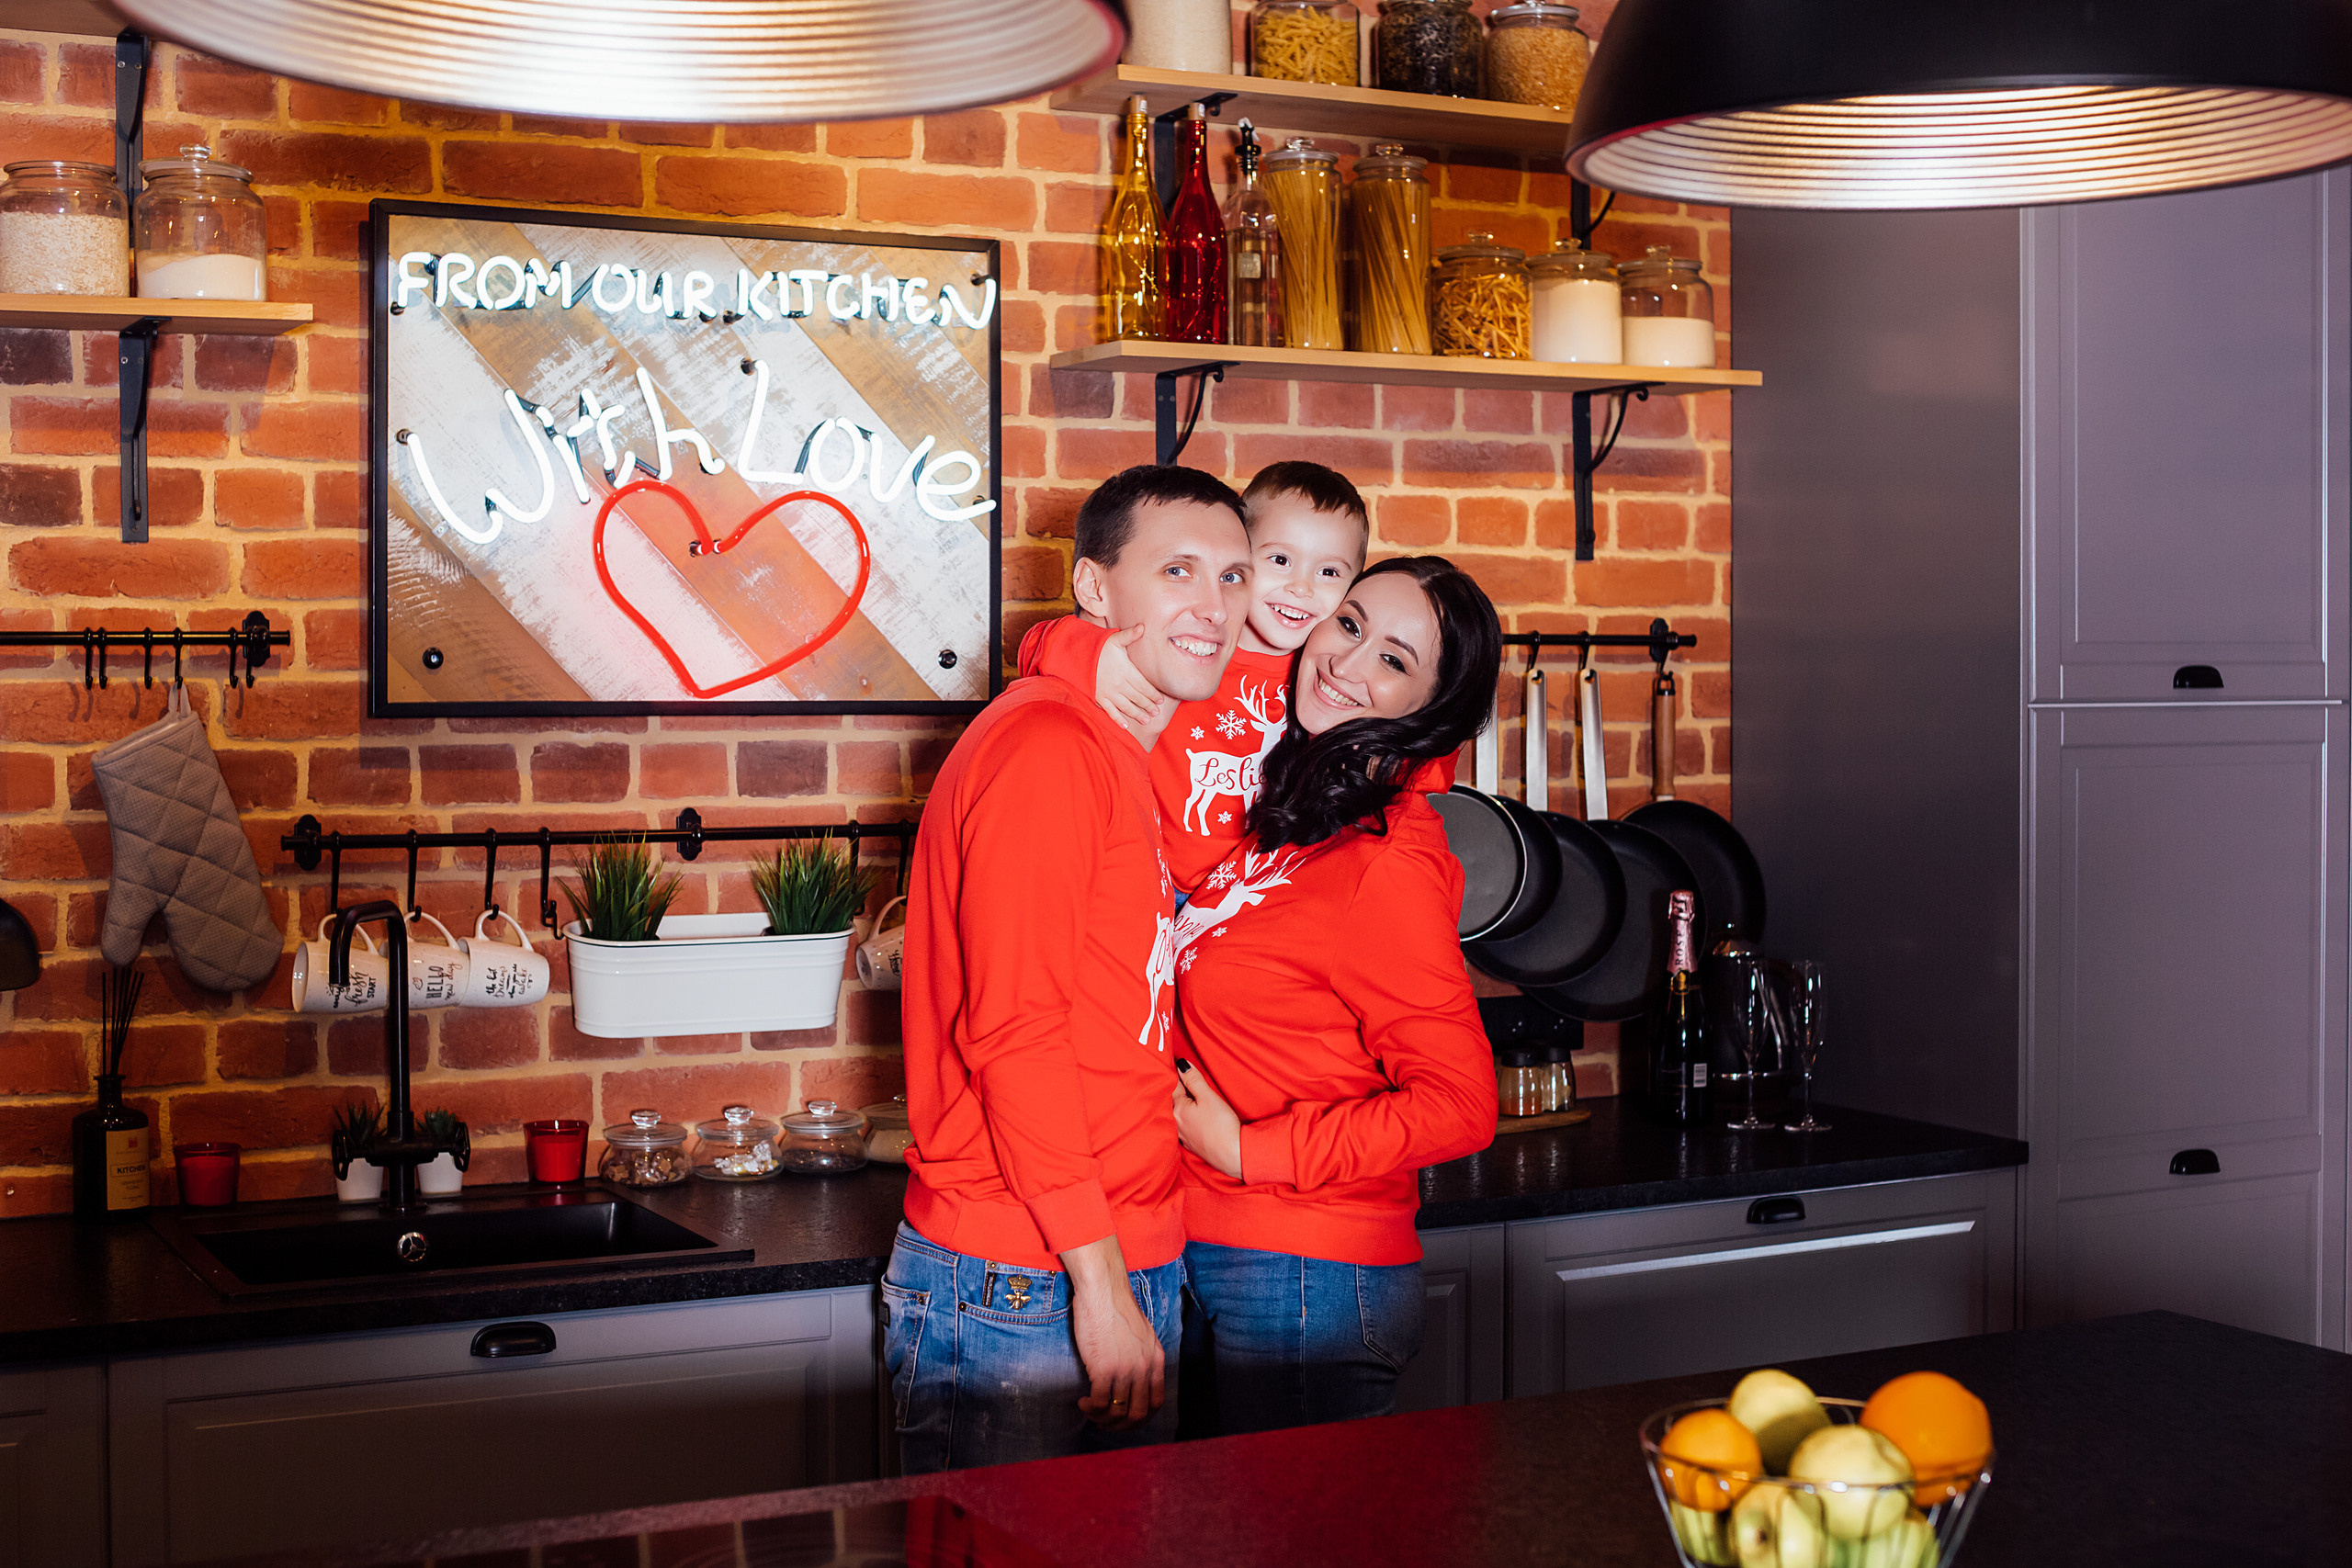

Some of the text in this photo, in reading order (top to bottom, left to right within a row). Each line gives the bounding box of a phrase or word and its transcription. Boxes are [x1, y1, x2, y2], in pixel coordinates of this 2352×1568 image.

[397, 252, 996, 330] FROM OUR KITCHEN
[406, 359, 997, 544] With Love
[345, 972, 368, 1007] fresh
[367, 976, 376, 998] START
[425, 965, 444, 998] HELLO
